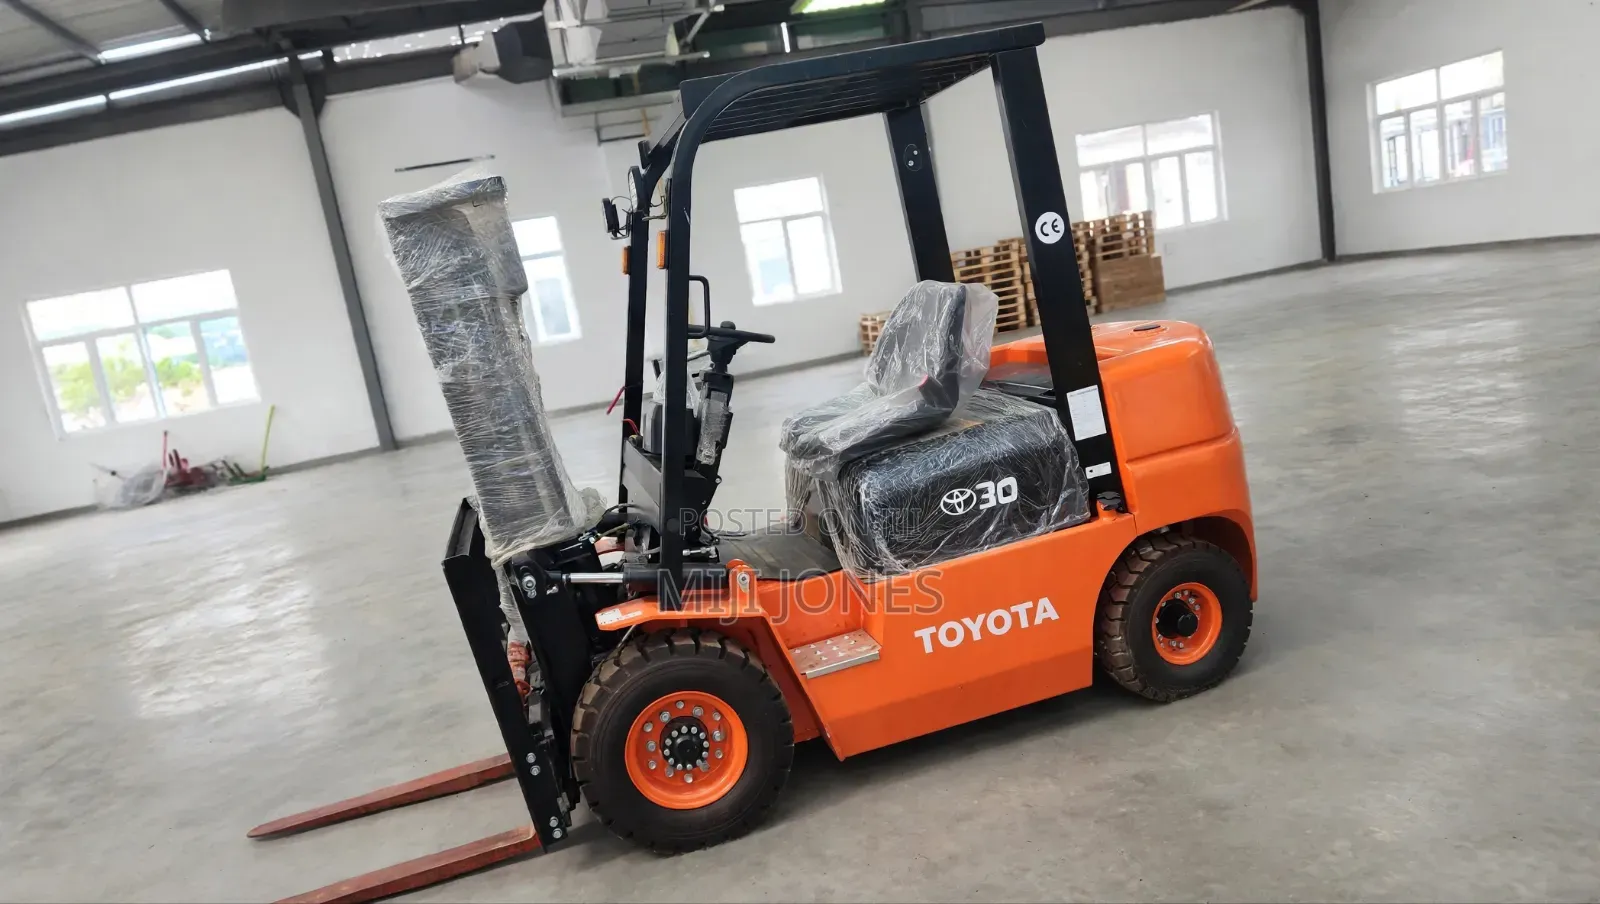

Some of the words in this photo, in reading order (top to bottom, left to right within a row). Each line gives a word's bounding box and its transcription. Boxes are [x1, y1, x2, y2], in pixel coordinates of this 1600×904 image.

[1040, 218, 1060, 237] CE
[976, 477, 1018, 510] 30
[914, 597, 1060, 654] TOYOTA
